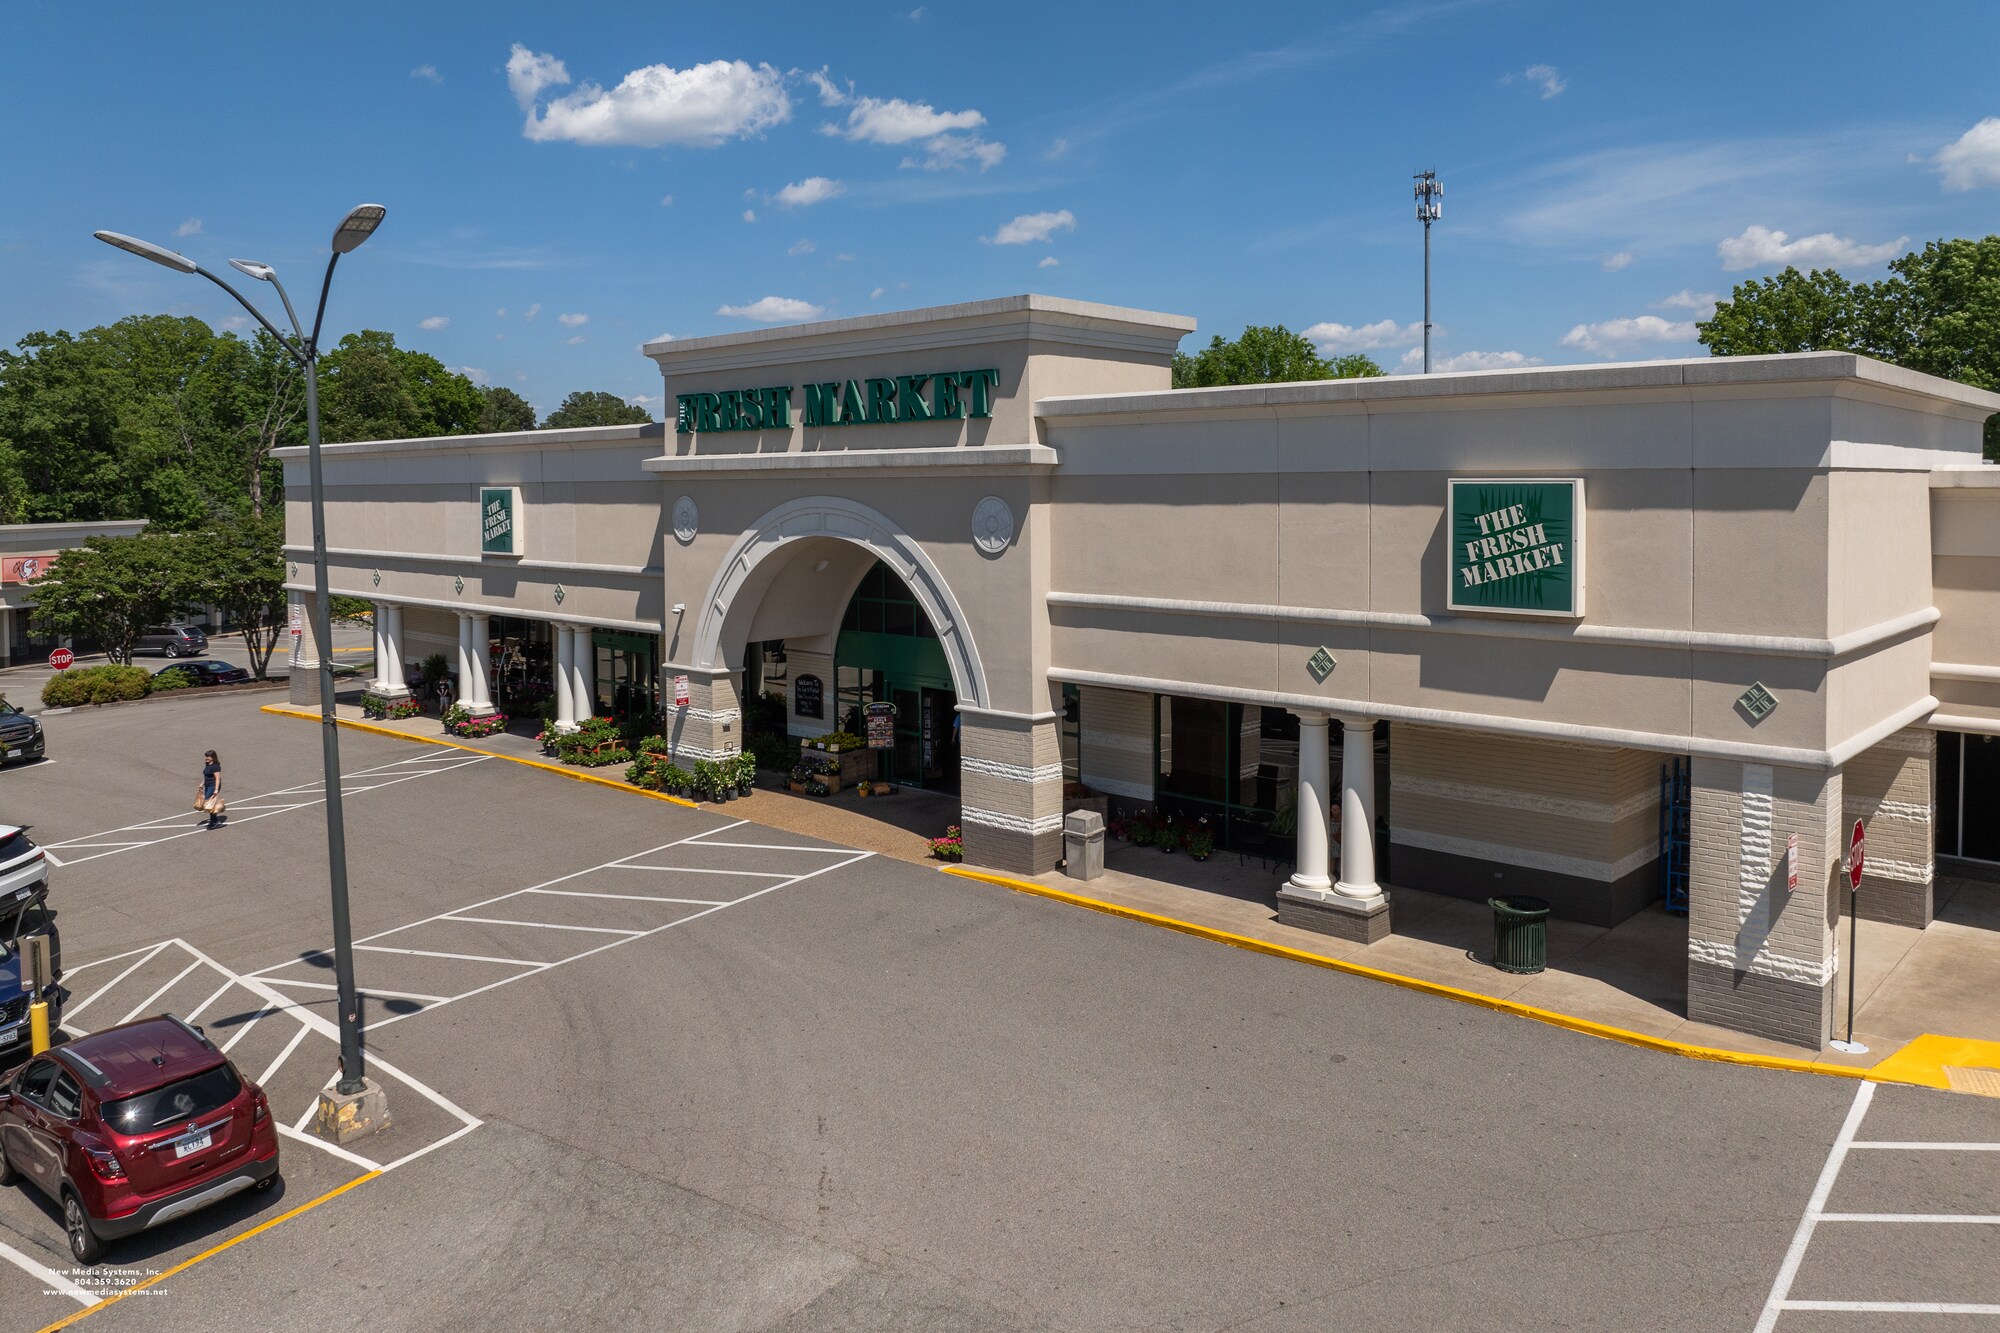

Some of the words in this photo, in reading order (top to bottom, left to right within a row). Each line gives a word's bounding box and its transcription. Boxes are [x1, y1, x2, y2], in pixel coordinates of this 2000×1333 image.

[676, 386, 794, 434] FRESH
[802, 368, 1000, 427] MARKET
[485, 509, 506, 530] FRESH
[487, 499, 501, 516] THE
[1474, 503, 1527, 536] THE
[484, 519, 511, 543] MARKET
[1465, 523, 1548, 563] FRESH
[1460, 543, 1564, 588] MARKET
[52, 654, 72, 665] STOP
[1850, 838, 1864, 872] STOP
